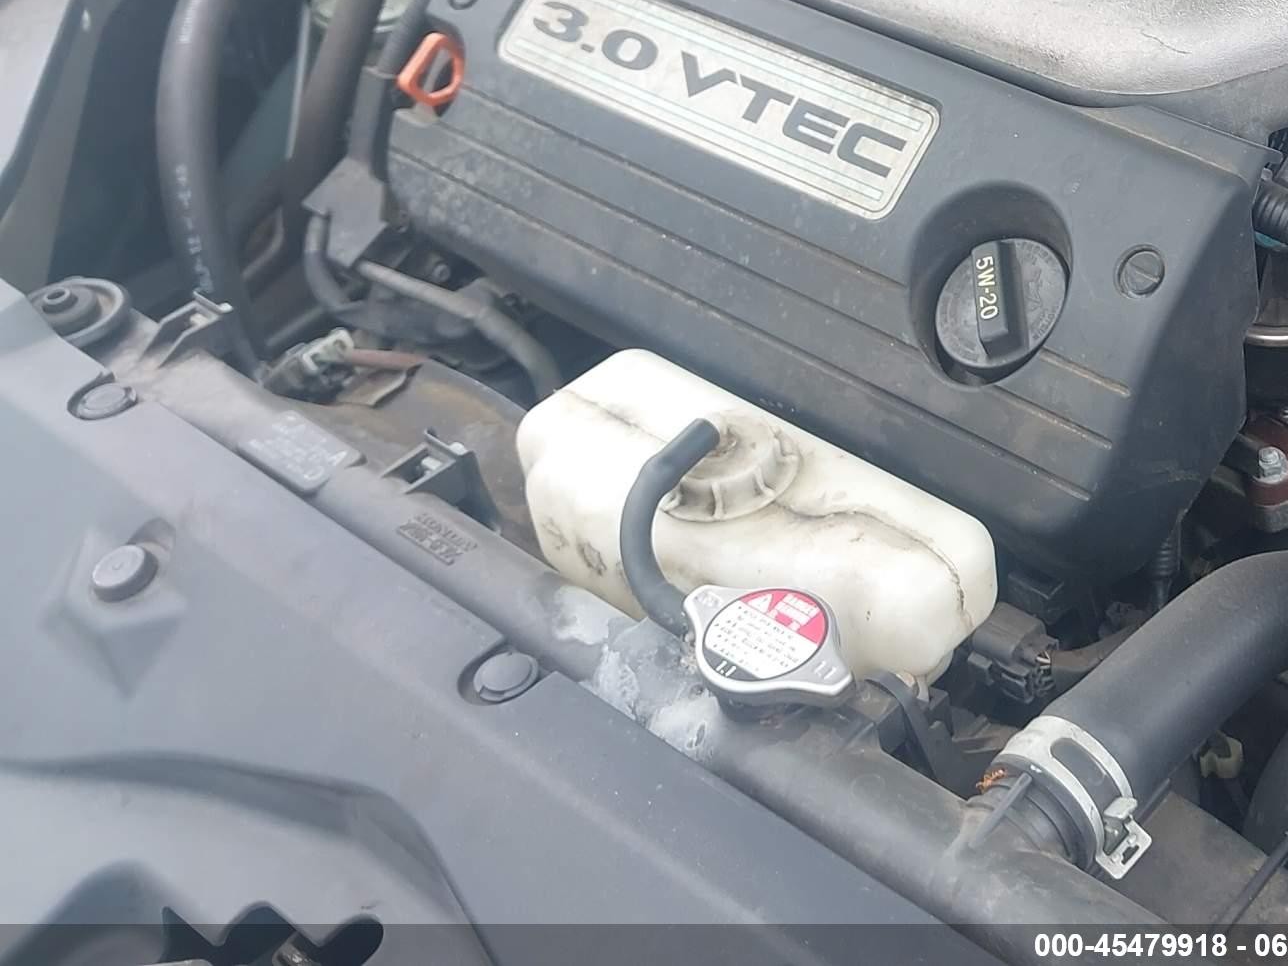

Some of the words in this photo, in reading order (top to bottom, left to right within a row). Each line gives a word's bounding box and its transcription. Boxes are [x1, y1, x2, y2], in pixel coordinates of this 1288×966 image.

[533, 1, 658, 71] 3.0
[681, 50, 907, 178] VTEC
[976, 256, 998, 319] 5W-20
[714, 658, 737, 678] 1.1
